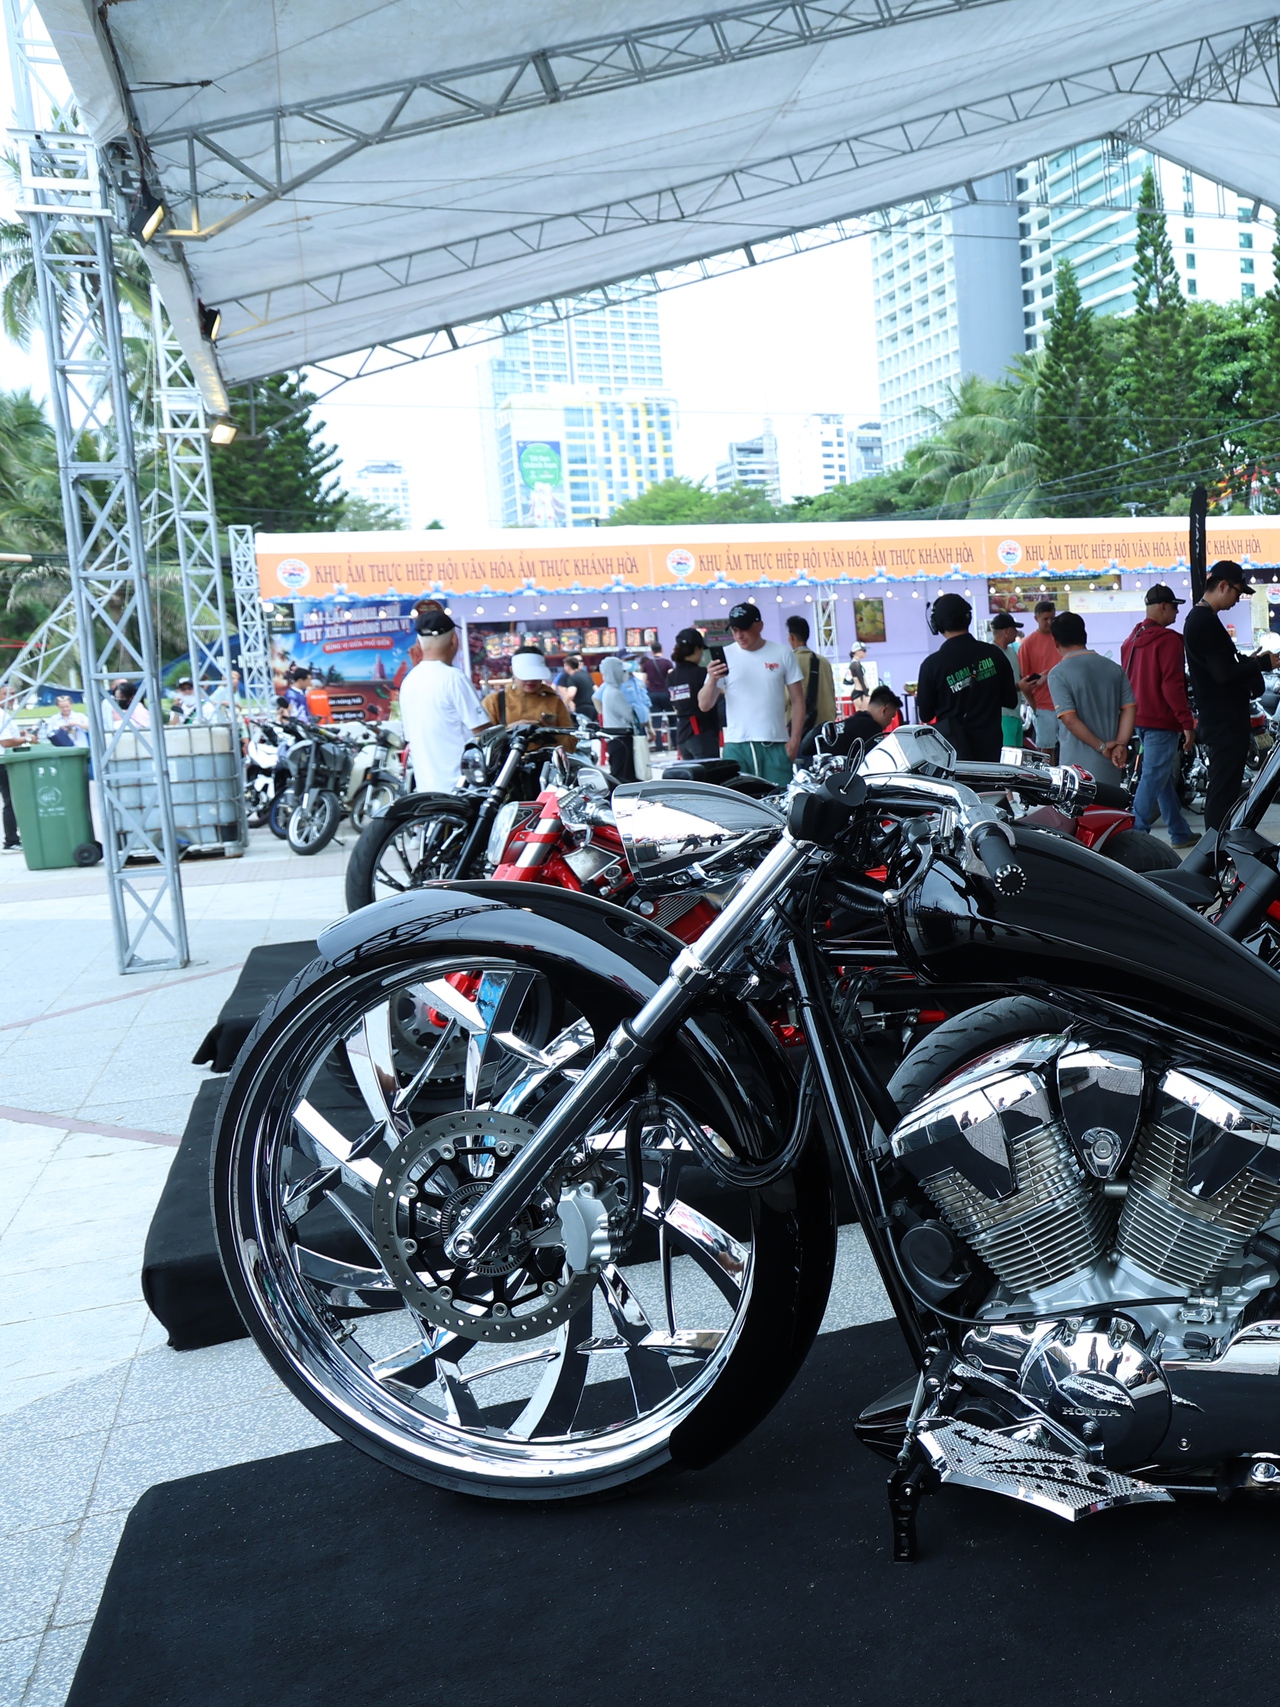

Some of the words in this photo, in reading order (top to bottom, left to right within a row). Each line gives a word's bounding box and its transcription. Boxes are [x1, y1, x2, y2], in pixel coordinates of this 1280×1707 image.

[698, 554, 721, 572] KHU
[725, 544, 742, 571] ẨM
[744, 552, 772, 574] THỰC
[776, 548, 800, 573] HIỆP
[803, 547, 821, 573] HỘI
[823, 548, 845, 568] VĂN
[847, 545, 868, 567] HÓA
[871, 541, 887, 566] ẨM
[889, 547, 916, 569] THỰC
[918, 543, 953, 565] KHÁNH
[955, 541, 975, 563] HÒA
[1025, 545, 1045, 561] KHU
[1048, 535, 1062, 560] ẨM
[1064, 541, 1089, 563] THỰC
[1091, 539, 1112, 563] HIỆP
[1114, 538, 1131, 562] HỘI
[1132, 538, 1150, 558] VĂN
[1152, 536, 1171, 557] HÓA
[1173, 532, 1187, 556] ẨM
[1213, 535, 1243, 555] KHÁNH
[1245, 534, 1262, 554] HÒA
[314, 565, 341, 584] KHU
[346, 554, 366, 582] ẨM
[368, 564, 402, 587] THỰC
[405, 558, 433, 586] HIỆP
[437, 557, 459, 585] HỘI
[462, 558, 486, 579] VĂN
[490, 555, 516, 579] HÓA
[518, 550, 537, 578] ẨM
[538, 558, 570, 581] THỰC
[573, 553, 614, 575] KHÁNH
[618, 551, 639, 574] HÒA
[1061, 1406, 1121, 1417] HONDA
